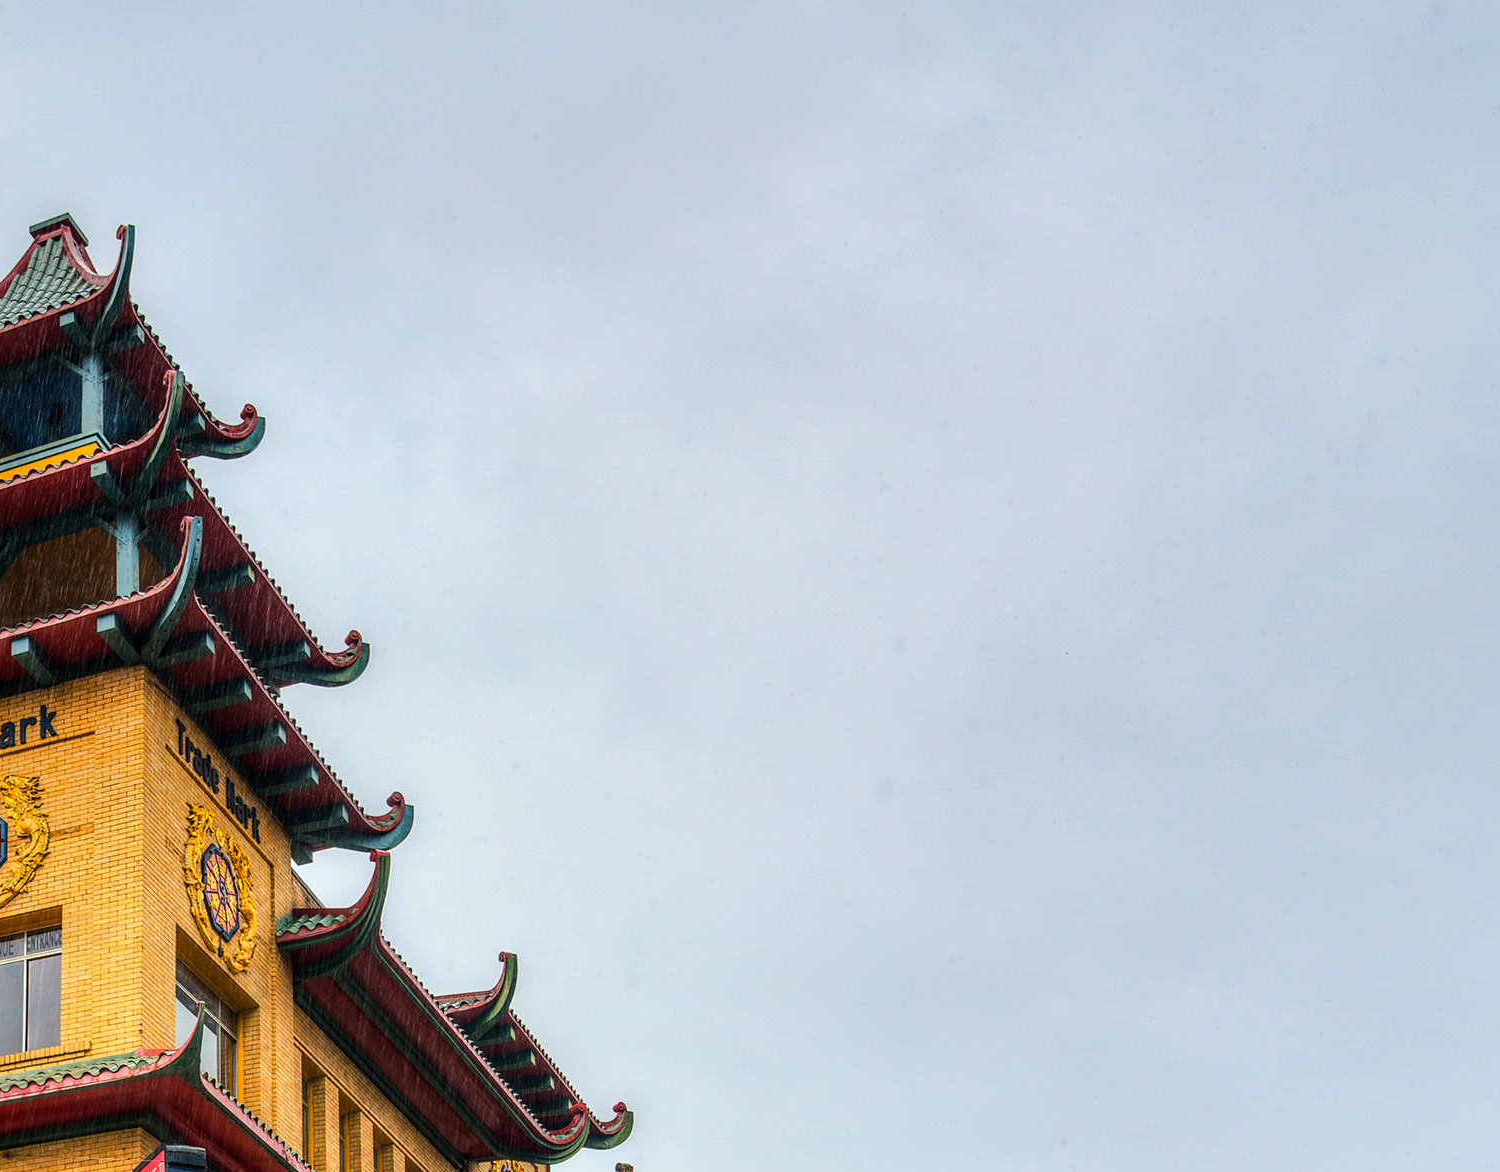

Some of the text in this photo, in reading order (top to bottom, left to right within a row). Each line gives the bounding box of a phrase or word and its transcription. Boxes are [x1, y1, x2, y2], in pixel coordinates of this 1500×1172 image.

[176, 718, 261, 844] Trade Mark
[26, 929, 62, 951] ENTRANCE
